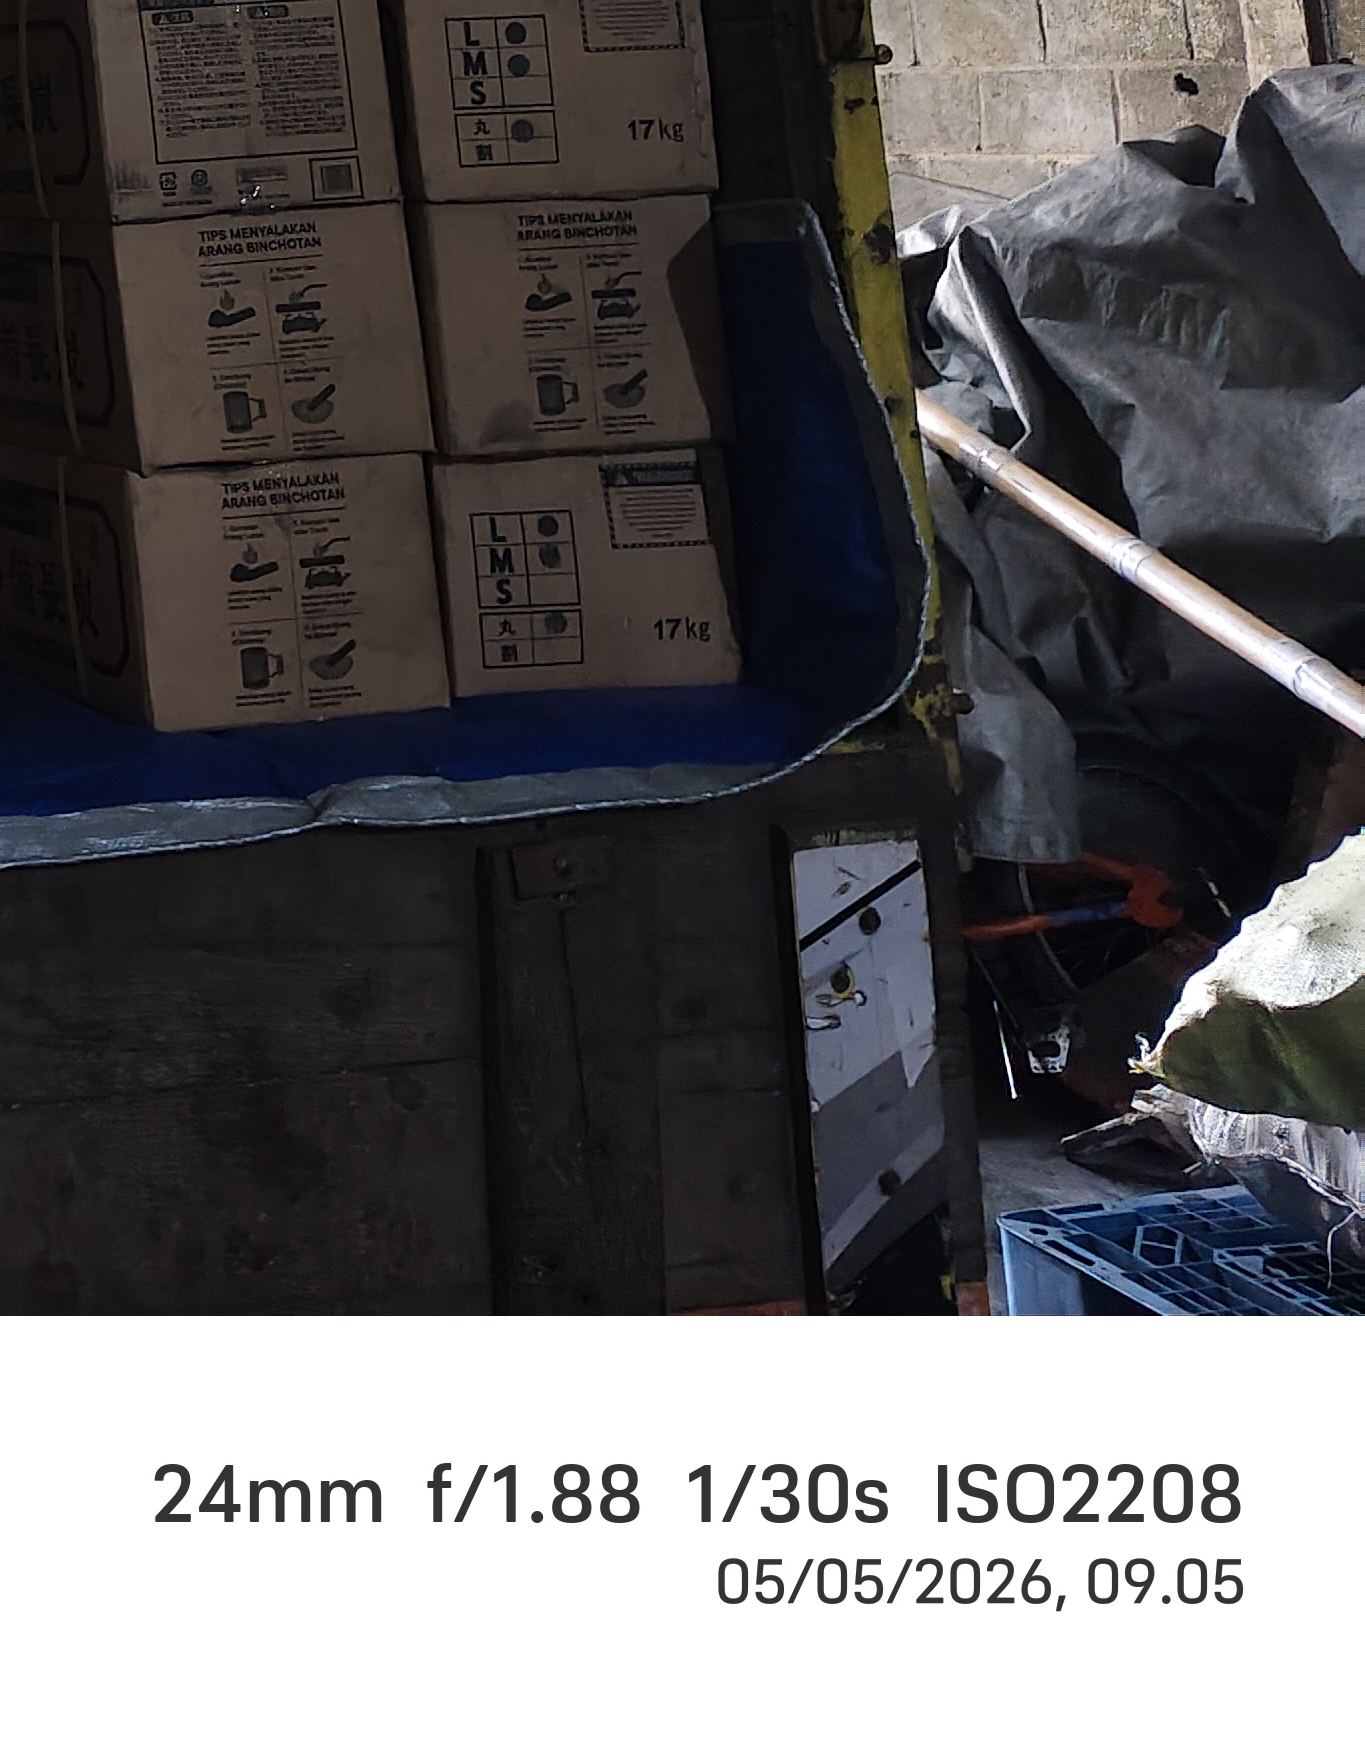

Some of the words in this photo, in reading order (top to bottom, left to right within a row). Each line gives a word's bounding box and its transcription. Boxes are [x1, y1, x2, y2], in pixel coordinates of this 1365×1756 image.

[463, 22, 479, 46] L
[463, 52, 487, 76] M
[470, 81, 486, 105] S
[199, 230, 227, 242] TIPS
[198, 244, 243, 257] ARANG
[222, 482, 249, 494] TIPS
[490, 517, 506, 542] L
[490, 548, 514, 573] M
[497, 579, 512, 604] S
